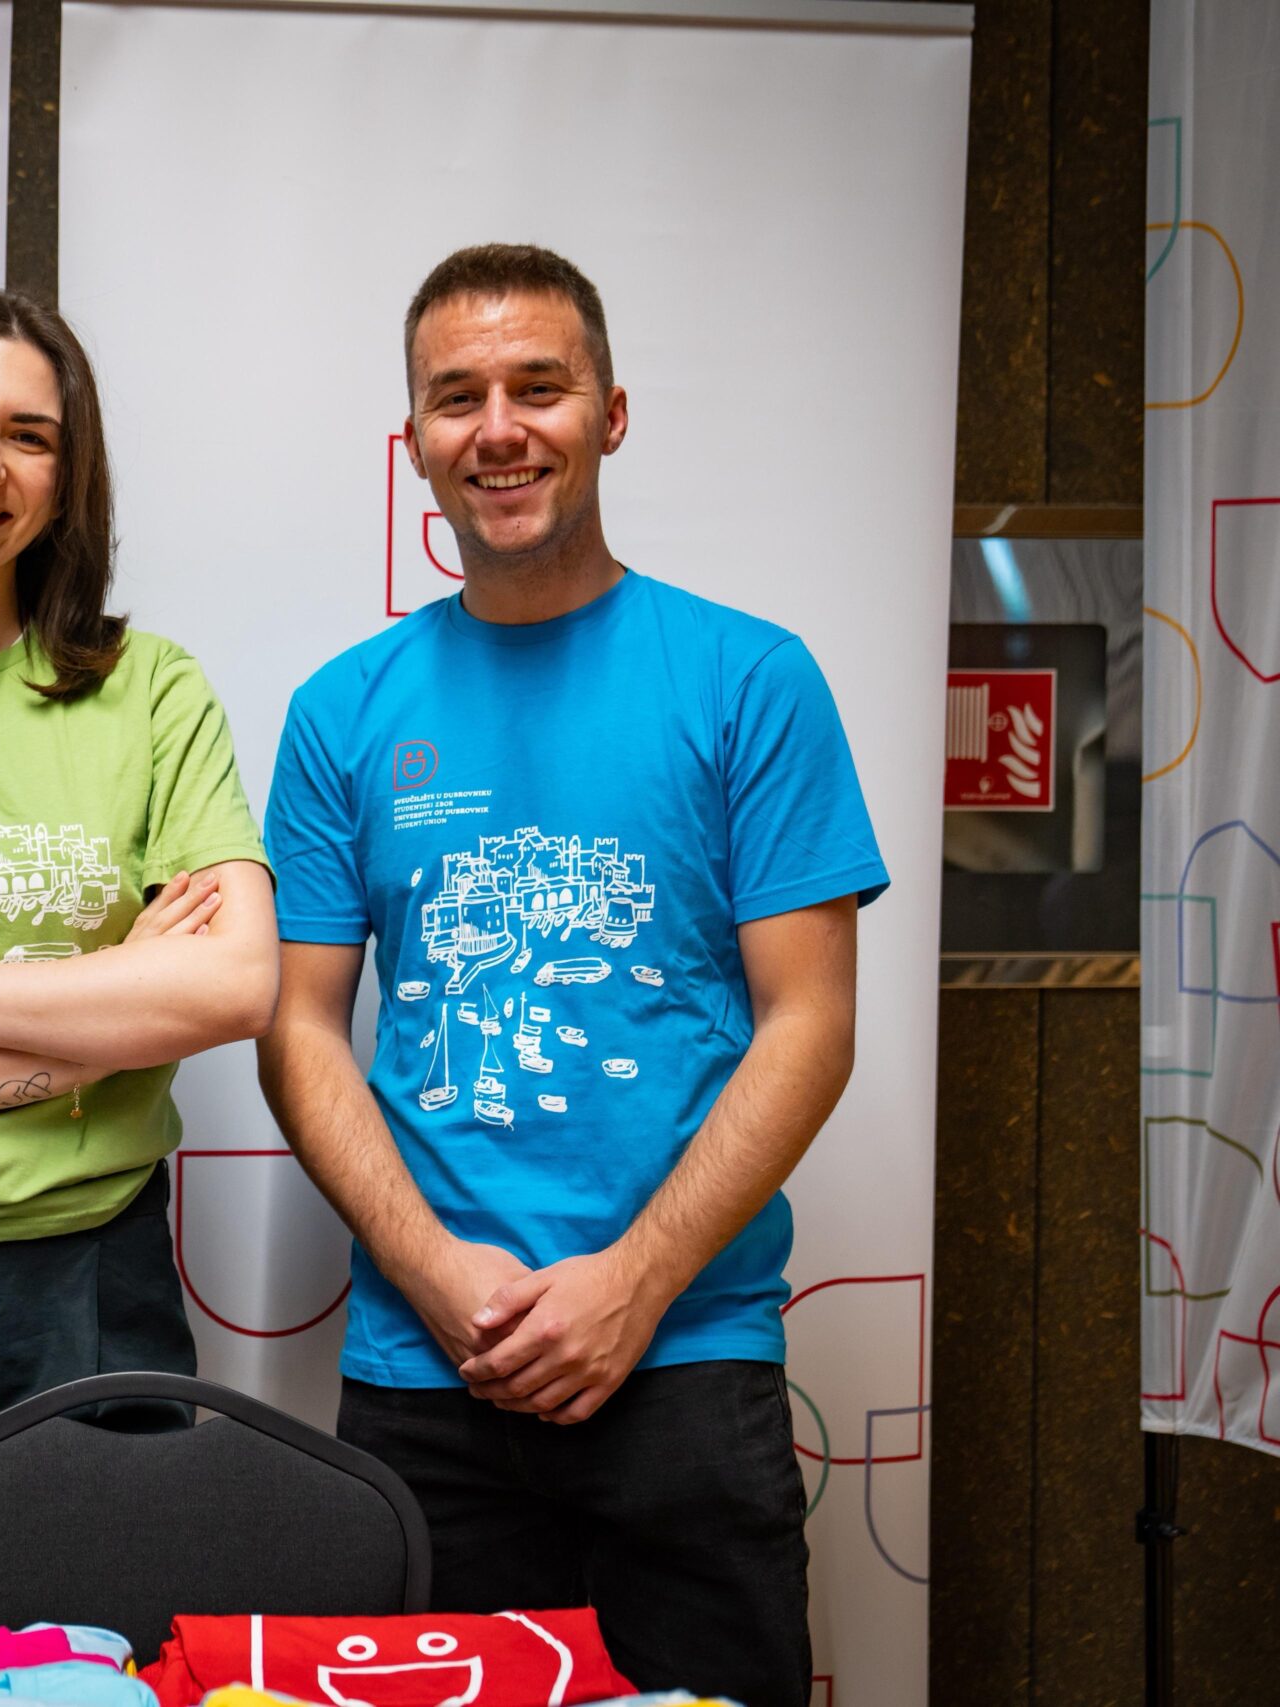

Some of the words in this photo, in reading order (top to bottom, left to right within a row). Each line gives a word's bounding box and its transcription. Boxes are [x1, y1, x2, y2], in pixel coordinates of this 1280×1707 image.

[443, 789, 492, 798] DUBROVNIKU
[394, 802, 433, 813] STUDENTSKI
[394, 811, 432, 822] UNIVERSITY
[445, 807, 489, 816] DUBROVNIK
[394, 820, 422, 830] STUDENT
